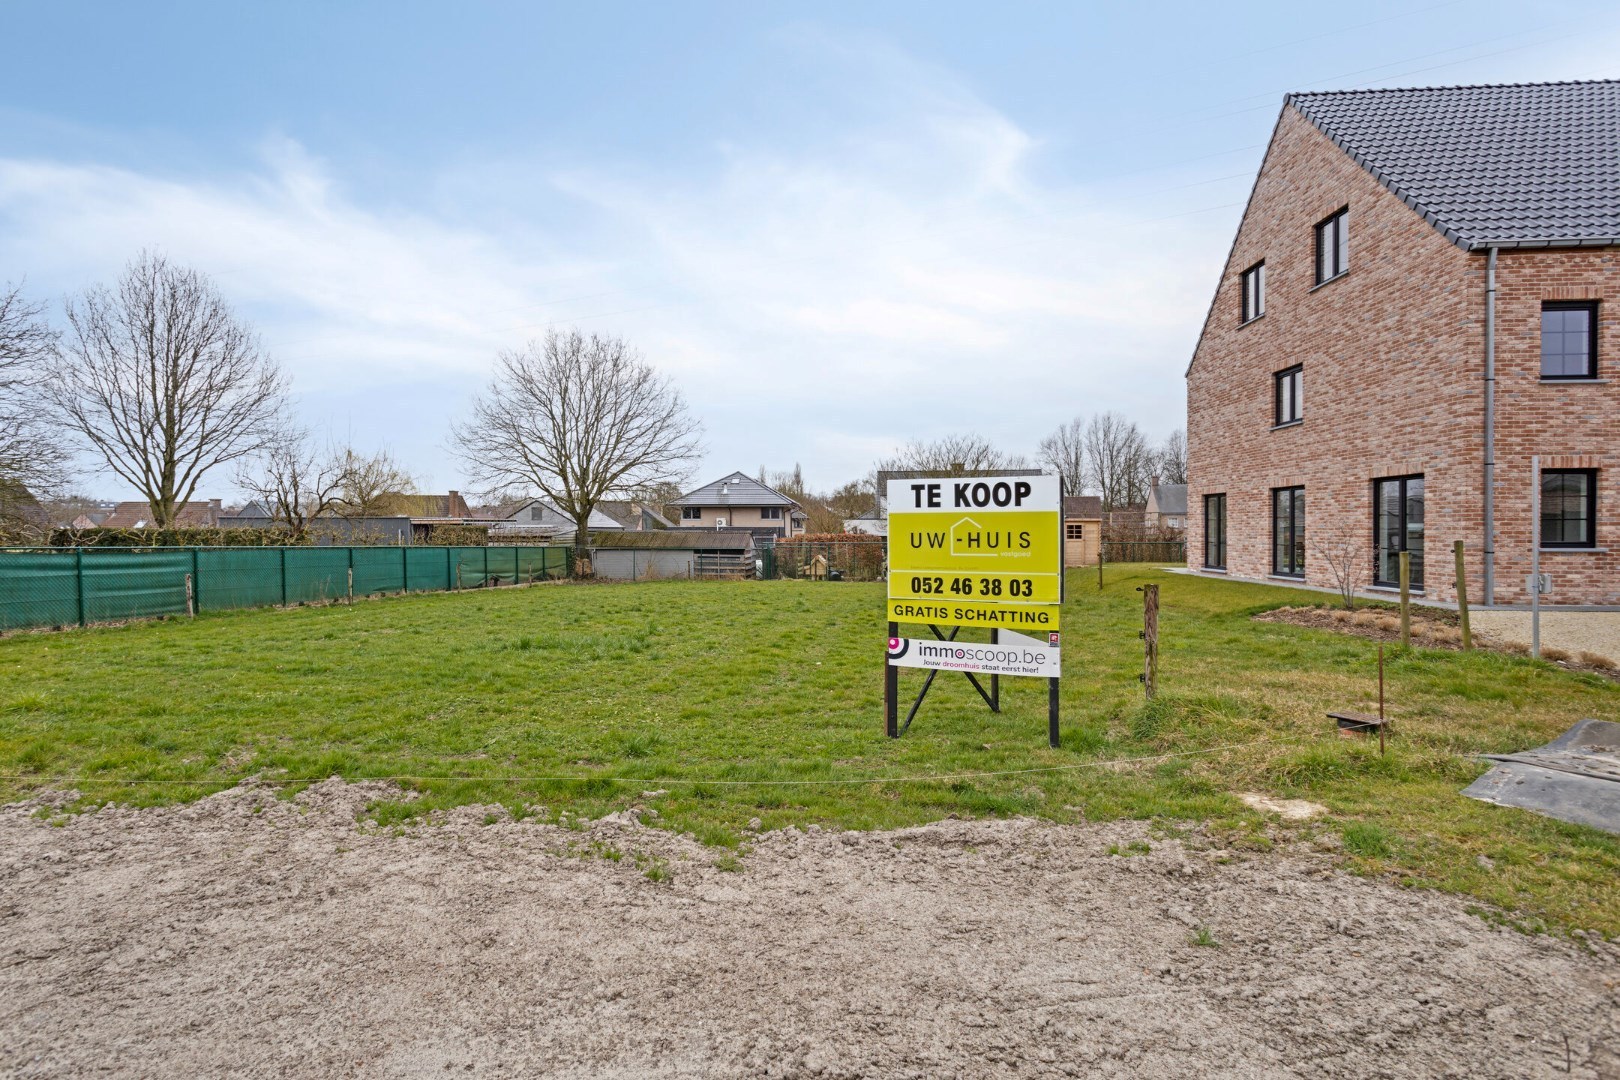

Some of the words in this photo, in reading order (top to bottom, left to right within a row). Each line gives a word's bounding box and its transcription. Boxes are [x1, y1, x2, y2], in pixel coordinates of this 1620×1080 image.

[911, 484, 941, 508] TE
[955, 482, 1031, 508] KOOP
[911, 577, 943, 594] 052
[951, 578, 972, 595] 46
[980, 578, 1002, 596] 38
[1010, 579, 1032, 597] 03
[894, 605, 948, 618] GRATIS
[954, 608, 1049, 623] SCHATTING
[919, 642, 1046, 665] immoscoop.be
[942, 661, 979, 669] droomhuis
[982, 663, 999, 671] staat
